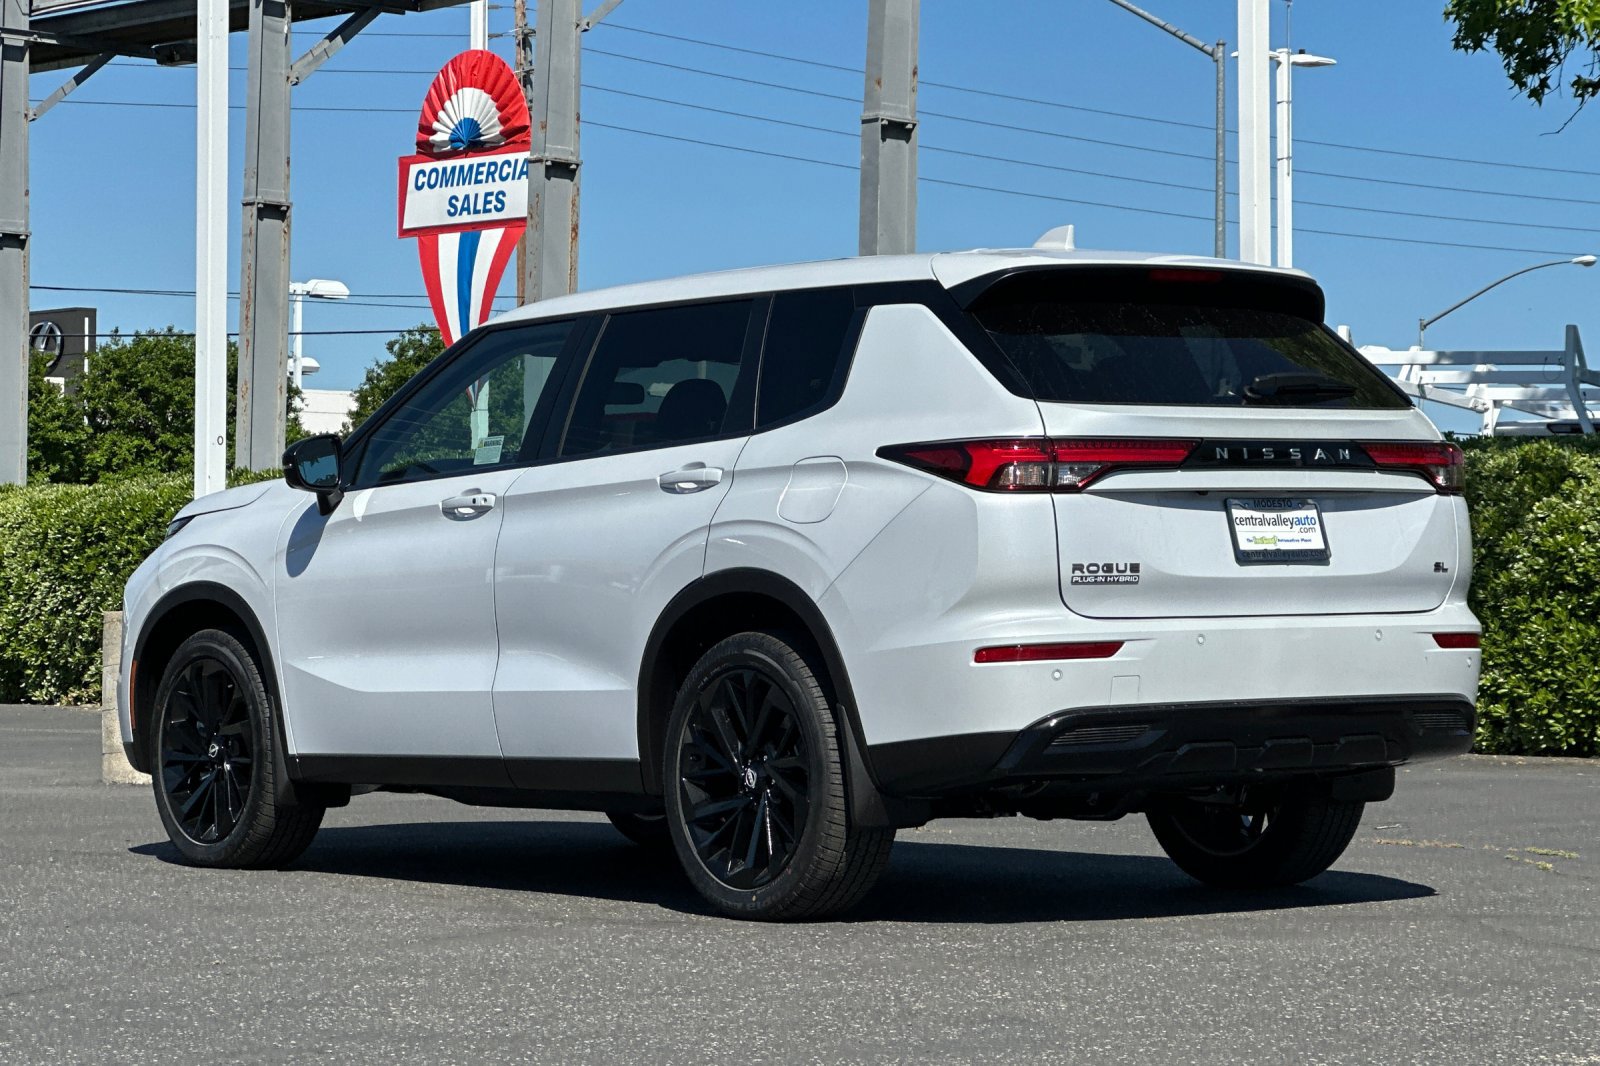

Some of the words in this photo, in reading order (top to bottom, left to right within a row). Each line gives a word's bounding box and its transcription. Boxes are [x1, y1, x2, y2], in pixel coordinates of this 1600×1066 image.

[446, 190, 507, 217] SALES
[1216, 447, 1350, 460] NISSAN
[1254, 500, 1293, 508] MODESTO
[1234, 514, 1317, 529] centralvalleyauto
[1072, 563, 1140, 574] ROGUE
